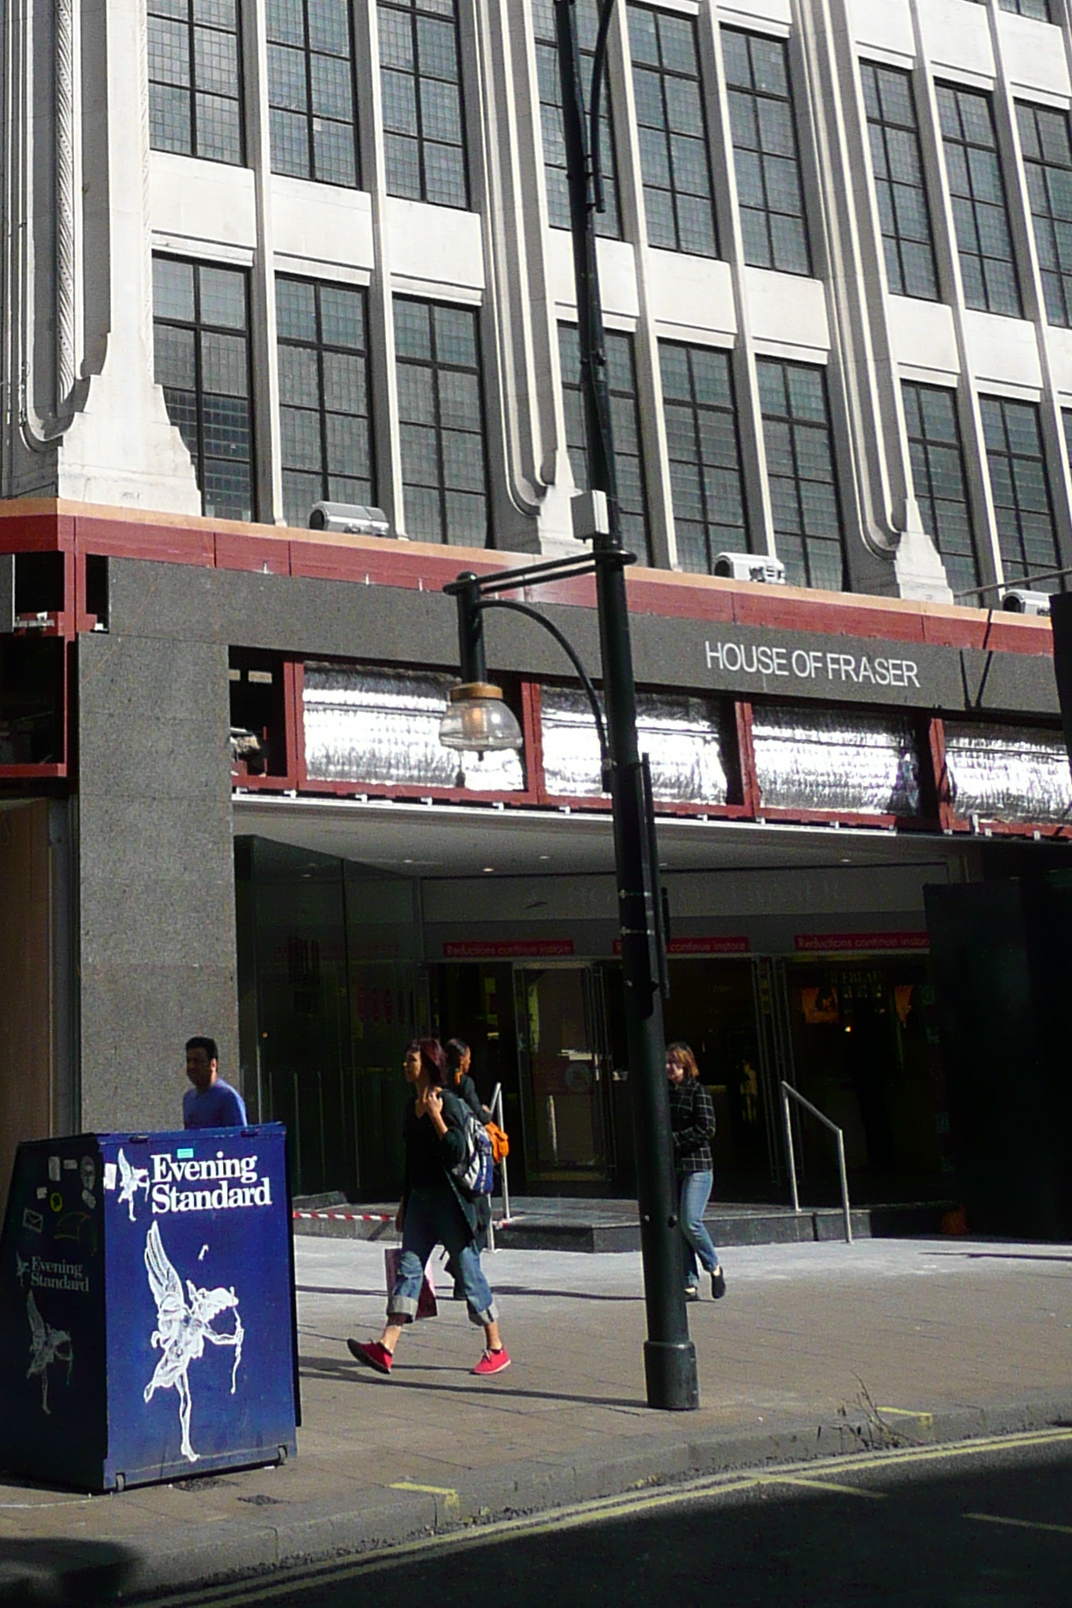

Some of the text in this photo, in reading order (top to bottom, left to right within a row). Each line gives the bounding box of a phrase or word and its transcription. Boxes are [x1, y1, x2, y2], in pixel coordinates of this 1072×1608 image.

[705, 641, 920, 688] HOUSE OF FRASER
[446, 943, 496, 956] Reductions
[497, 944, 537, 955] continue
[671, 939, 746, 952] continue instore
[798, 935, 930, 948] Reductions continue instor
[150, 1150, 258, 1184] Evening
[151, 1177, 273, 1214] Standard
[31, 1255, 84, 1278] Evening
[30, 1272, 90, 1292] Standard
